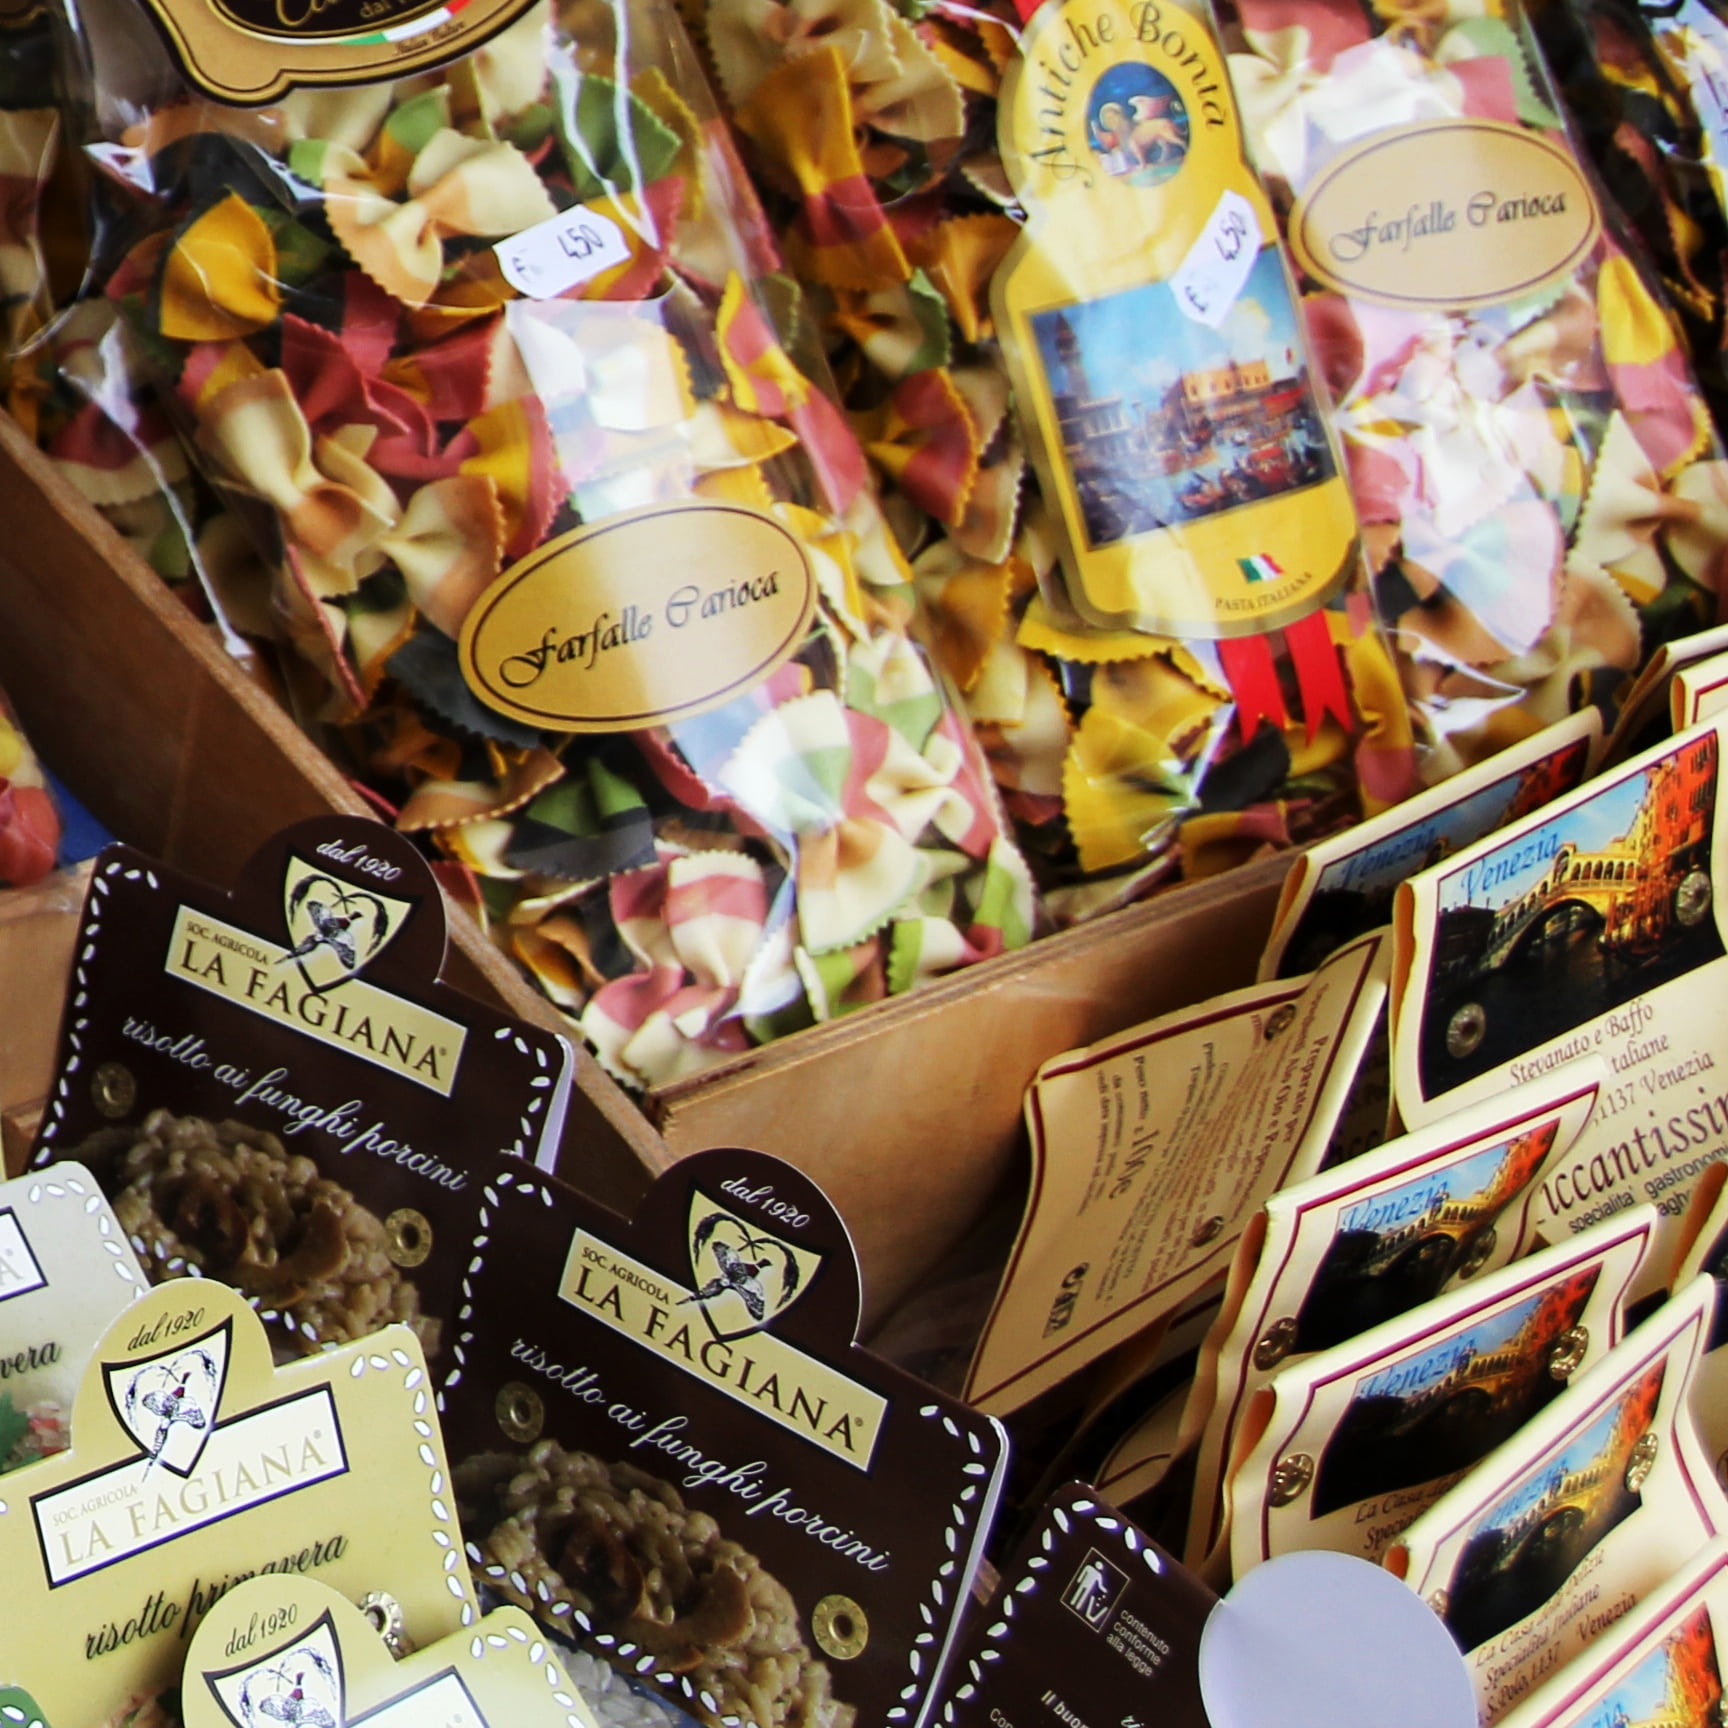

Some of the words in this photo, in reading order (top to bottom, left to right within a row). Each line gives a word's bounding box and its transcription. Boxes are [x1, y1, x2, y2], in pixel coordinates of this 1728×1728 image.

[1328, 197, 1458, 264] Farfalle
[1466, 188, 1569, 228] Carioca
[498, 604, 653, 690] Farfalle
[663, 570, 781, 631] Carioca
[1459, 828, 1561, 896] Venezia
[186, 919, 212, 945] SOC.
[211, 931, 270, 966] AGRICOLA
[179, 938, 227, 988] LA
[244, 968, 442, 1082] FAGIANA
[1509, 1033, 1591, 1089] Stevanato
[1605, 997, 1654, 1038] Baffo
[121, 1014, 211, 1070] risotto
[213, 1062, 250, 1089] ai
[236, 1065, 361, 1140] funghi
[349, 1126, 468, 1193] porcini
[582, 1246, 609, 1271] SOC.
[608, 1257, 670, 1306] AGRICOLA
[574, 1264, 625, 1321] LA
[642, 1308, 856, 1453] FAGIANA
[510, 1337, 607, 1405] risotto
[607, 1399, 647, 1433] ai
[629, 1415, 768, 1503] funghi
[745, 1484, 892, 1573] porcini
[57, 1522, 113, 1567] LA
[126, 1434, 329, 1541] FAGIANA
[1105, 1631, 1126, 1654] alla
[1122, 1643, 1156, 1678] legge
[1112, 1620, 1163, 1667] conforme
[1119, 1608, 1171, 1656] contenuto
